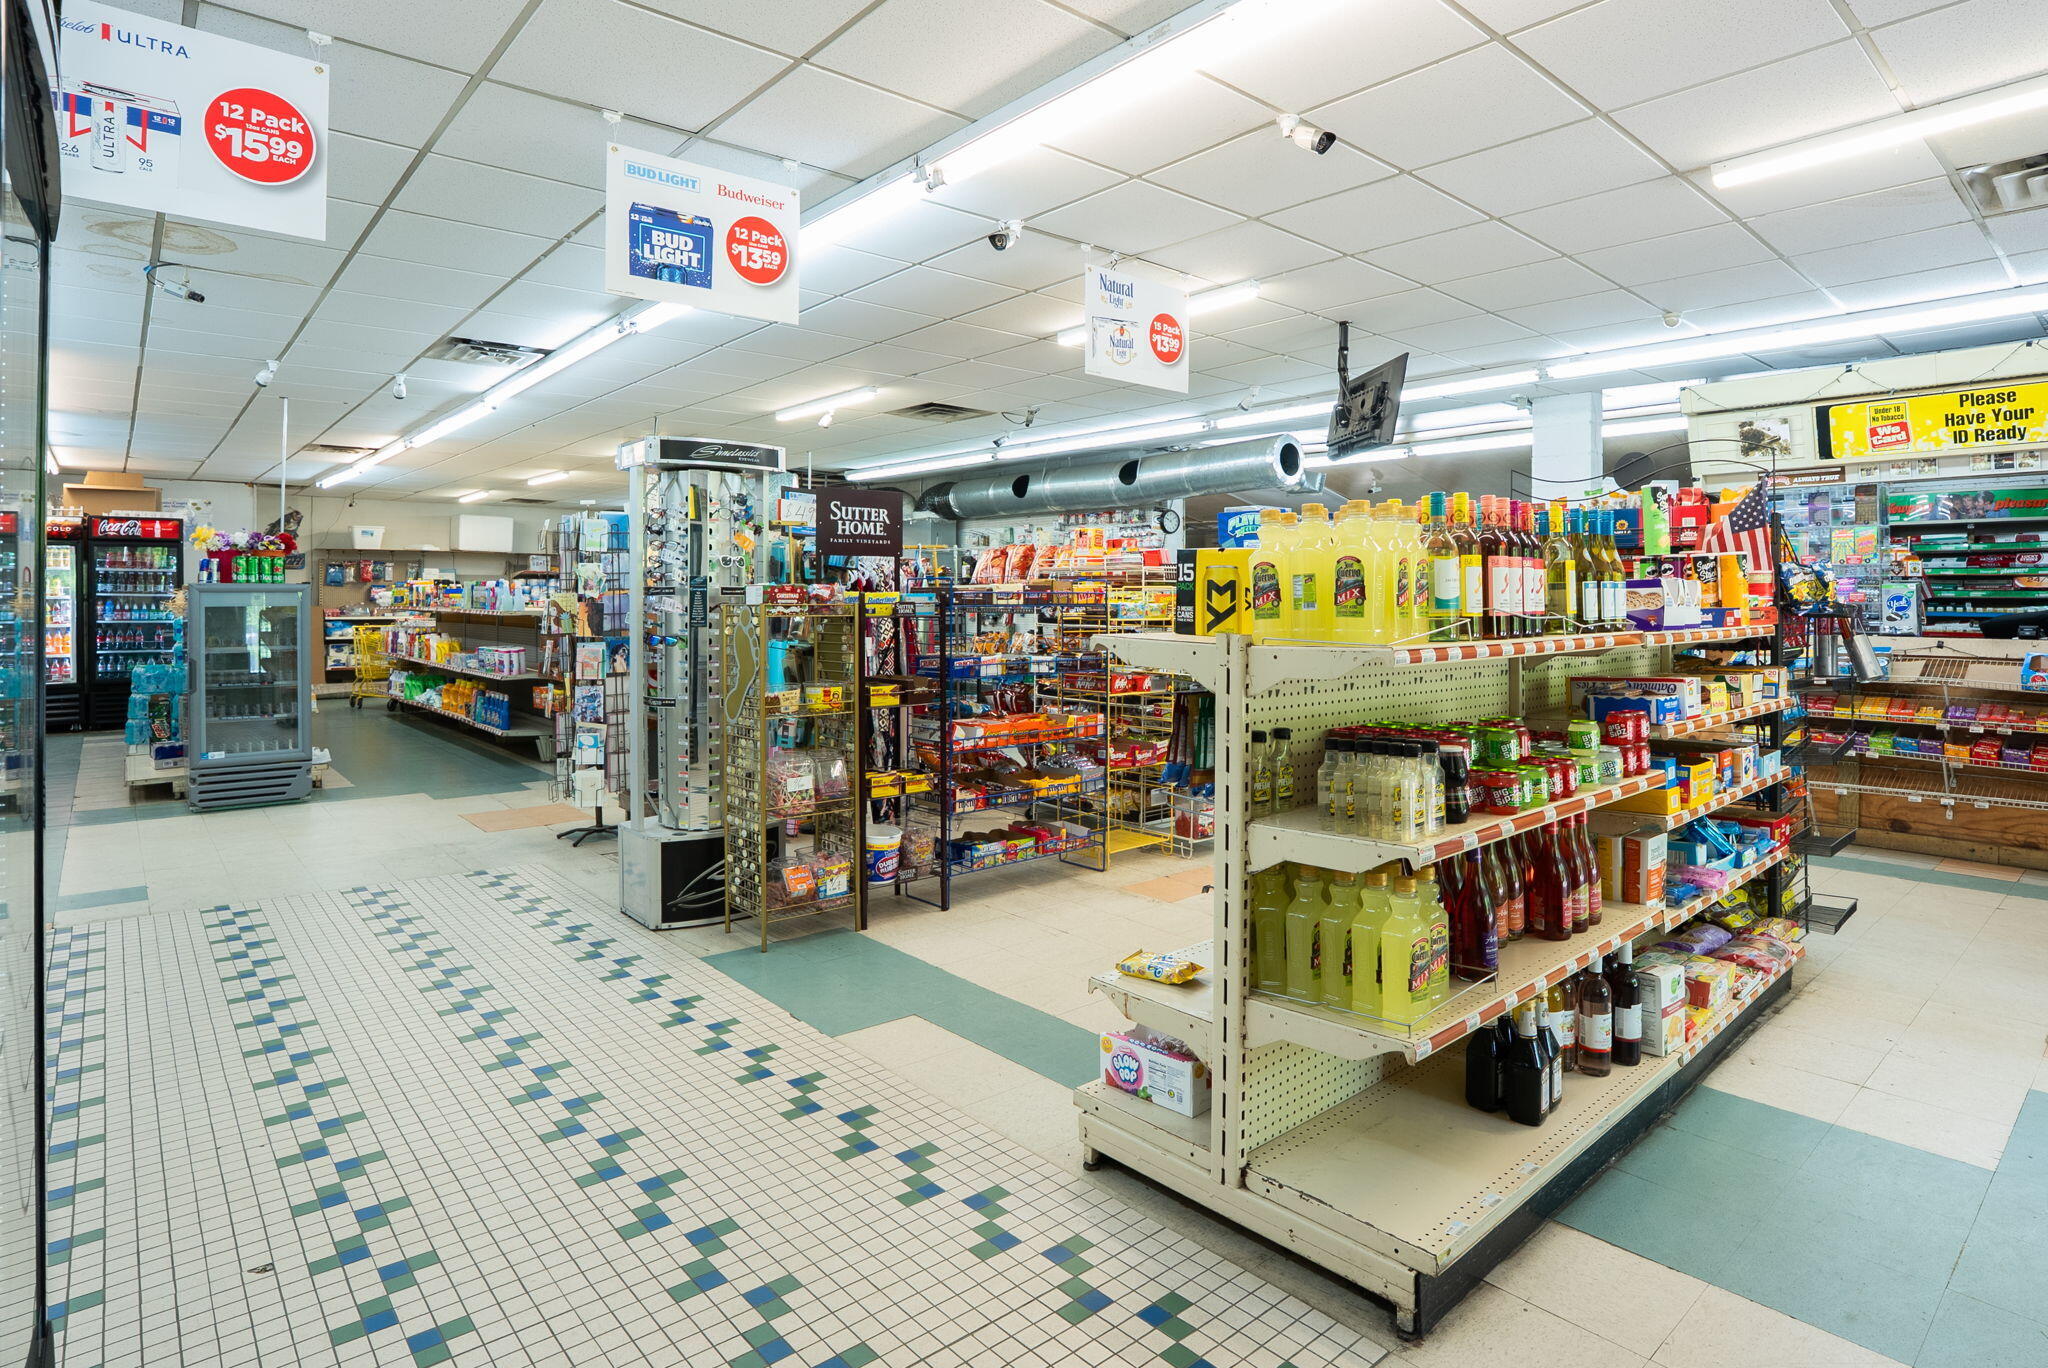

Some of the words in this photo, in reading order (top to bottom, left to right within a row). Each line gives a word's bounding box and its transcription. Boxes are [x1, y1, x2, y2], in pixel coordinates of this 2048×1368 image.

[117, 29, 190, 59] ULTRA
[219, 101, 244, 120] 12
[250, 108, 305, 134] Pack
[103, 116, 115, 158] ULTRA
[61, 142, 79, 153] 2.6
[138, 157, 153, 168] 95
[272, 155, 297, 165] EACH
[626, 163, 657, 180] BUD
[658, 171, 698, 190] LIGHT
[716, 183, 785, 211] Budweiser
[651, 229, 694, 251] BUD
[734, 226, 748, 240] 12
[752, 230, 783, 248] Pack
[1099, 272, 1134, 298] Natural
[1108, 294, 1124, 309] Light
[1153, 321, 1162, 332] 15
[1163, 324, 1181, 336] Pack
[1109, 334, 1134, 349] Natural
[1959, 390, 2017, 408] Please
[1872, 415, 1880, 423] No
[1881, 412, 1904, 422] Tobacco
[1874, 407, 1892, 415] Under
[1893, 405, 1901, 413] 18
[1945, 412, 1985, 428] Have
[1989, 407, 2035, 423] Your
[1872, 431, 1907, 446] Card
[1876, 425, 1901, 437] We
[1953, 430, 1969, 444] ID
[1974, 425, 2027, 443] Ready
[830, 501, 891, 524] SUTTER
[1178, 563, 1194, 582] 15
[1178, 582, 1194, 590] PACK
[1255, 591, 1276, 607] MIX
[1337, 588, 1360, 604] MIX
[1430, 952, 1447, 972] MIX
[1412, 968, 1430, 989] MIX
[1112, 1053, 1140, 1071] BLOW
[1119, 1068, 1138, 1083] POP
